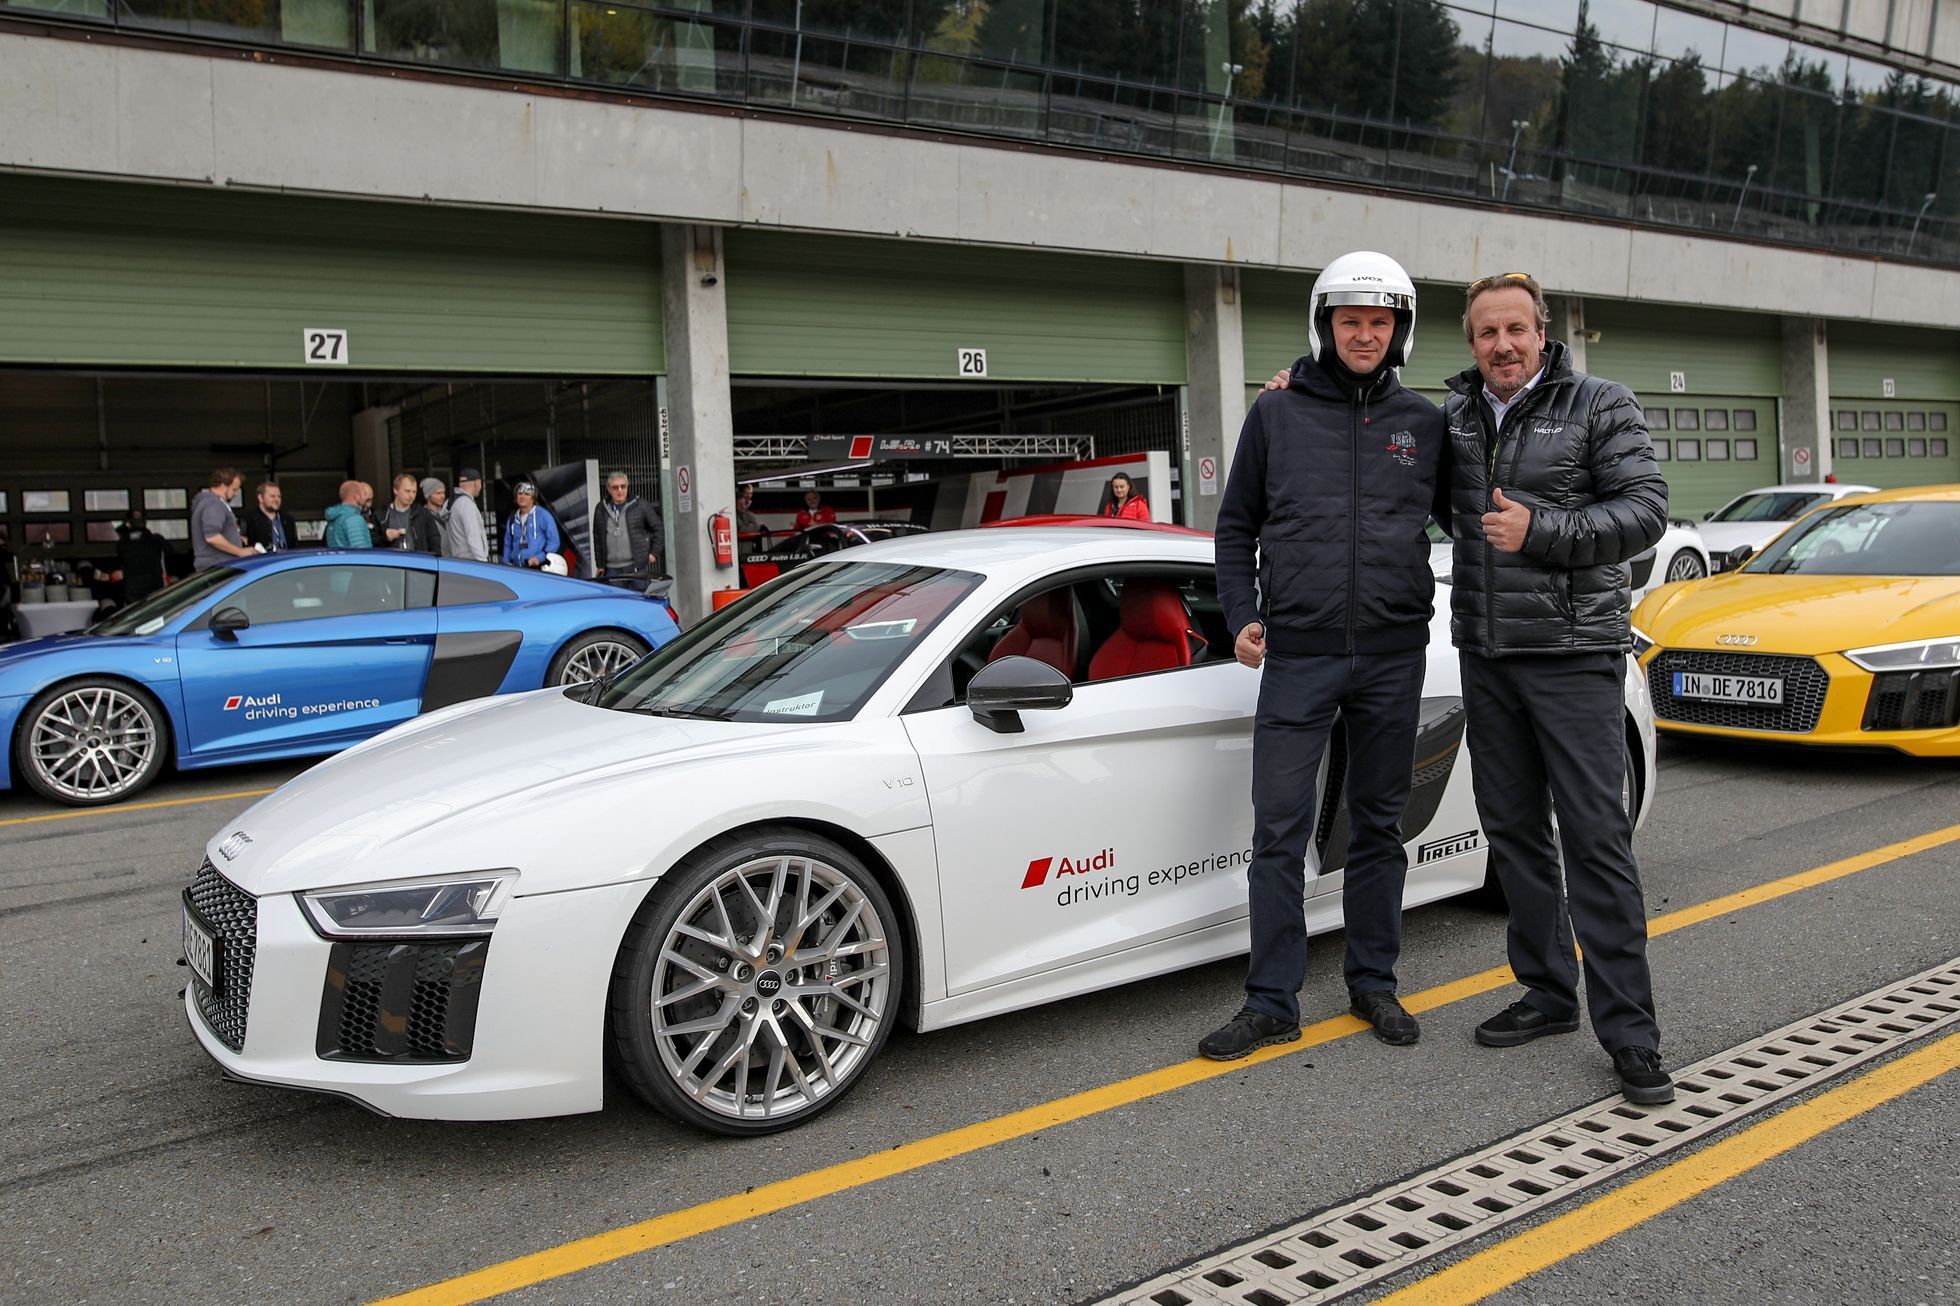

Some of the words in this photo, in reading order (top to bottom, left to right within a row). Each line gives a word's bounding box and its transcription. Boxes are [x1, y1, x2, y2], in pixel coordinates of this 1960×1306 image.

[310, 333, 342, 360] 27
[963, 352, 984, 373] 26
[1672, 374, 1683, 389] 24
[660, 408, 669, 459] kreno.tech
[244, 693, 281, 707] Audi
[1684, 675, 1700, 694] IN
[1712, 677, 1732, 697] DE
[1736, 680, 1778, 700] 7816
[245, 705, 297, 720] driving
[301, 698, 380, 715] experience
[1417, 829, 1478, 864] PIRELLI
[1056, 847, 1115, 879] Audi
[1057, 875, 1140, 906] driving
[1148, 849, 1253, 885] experienc
